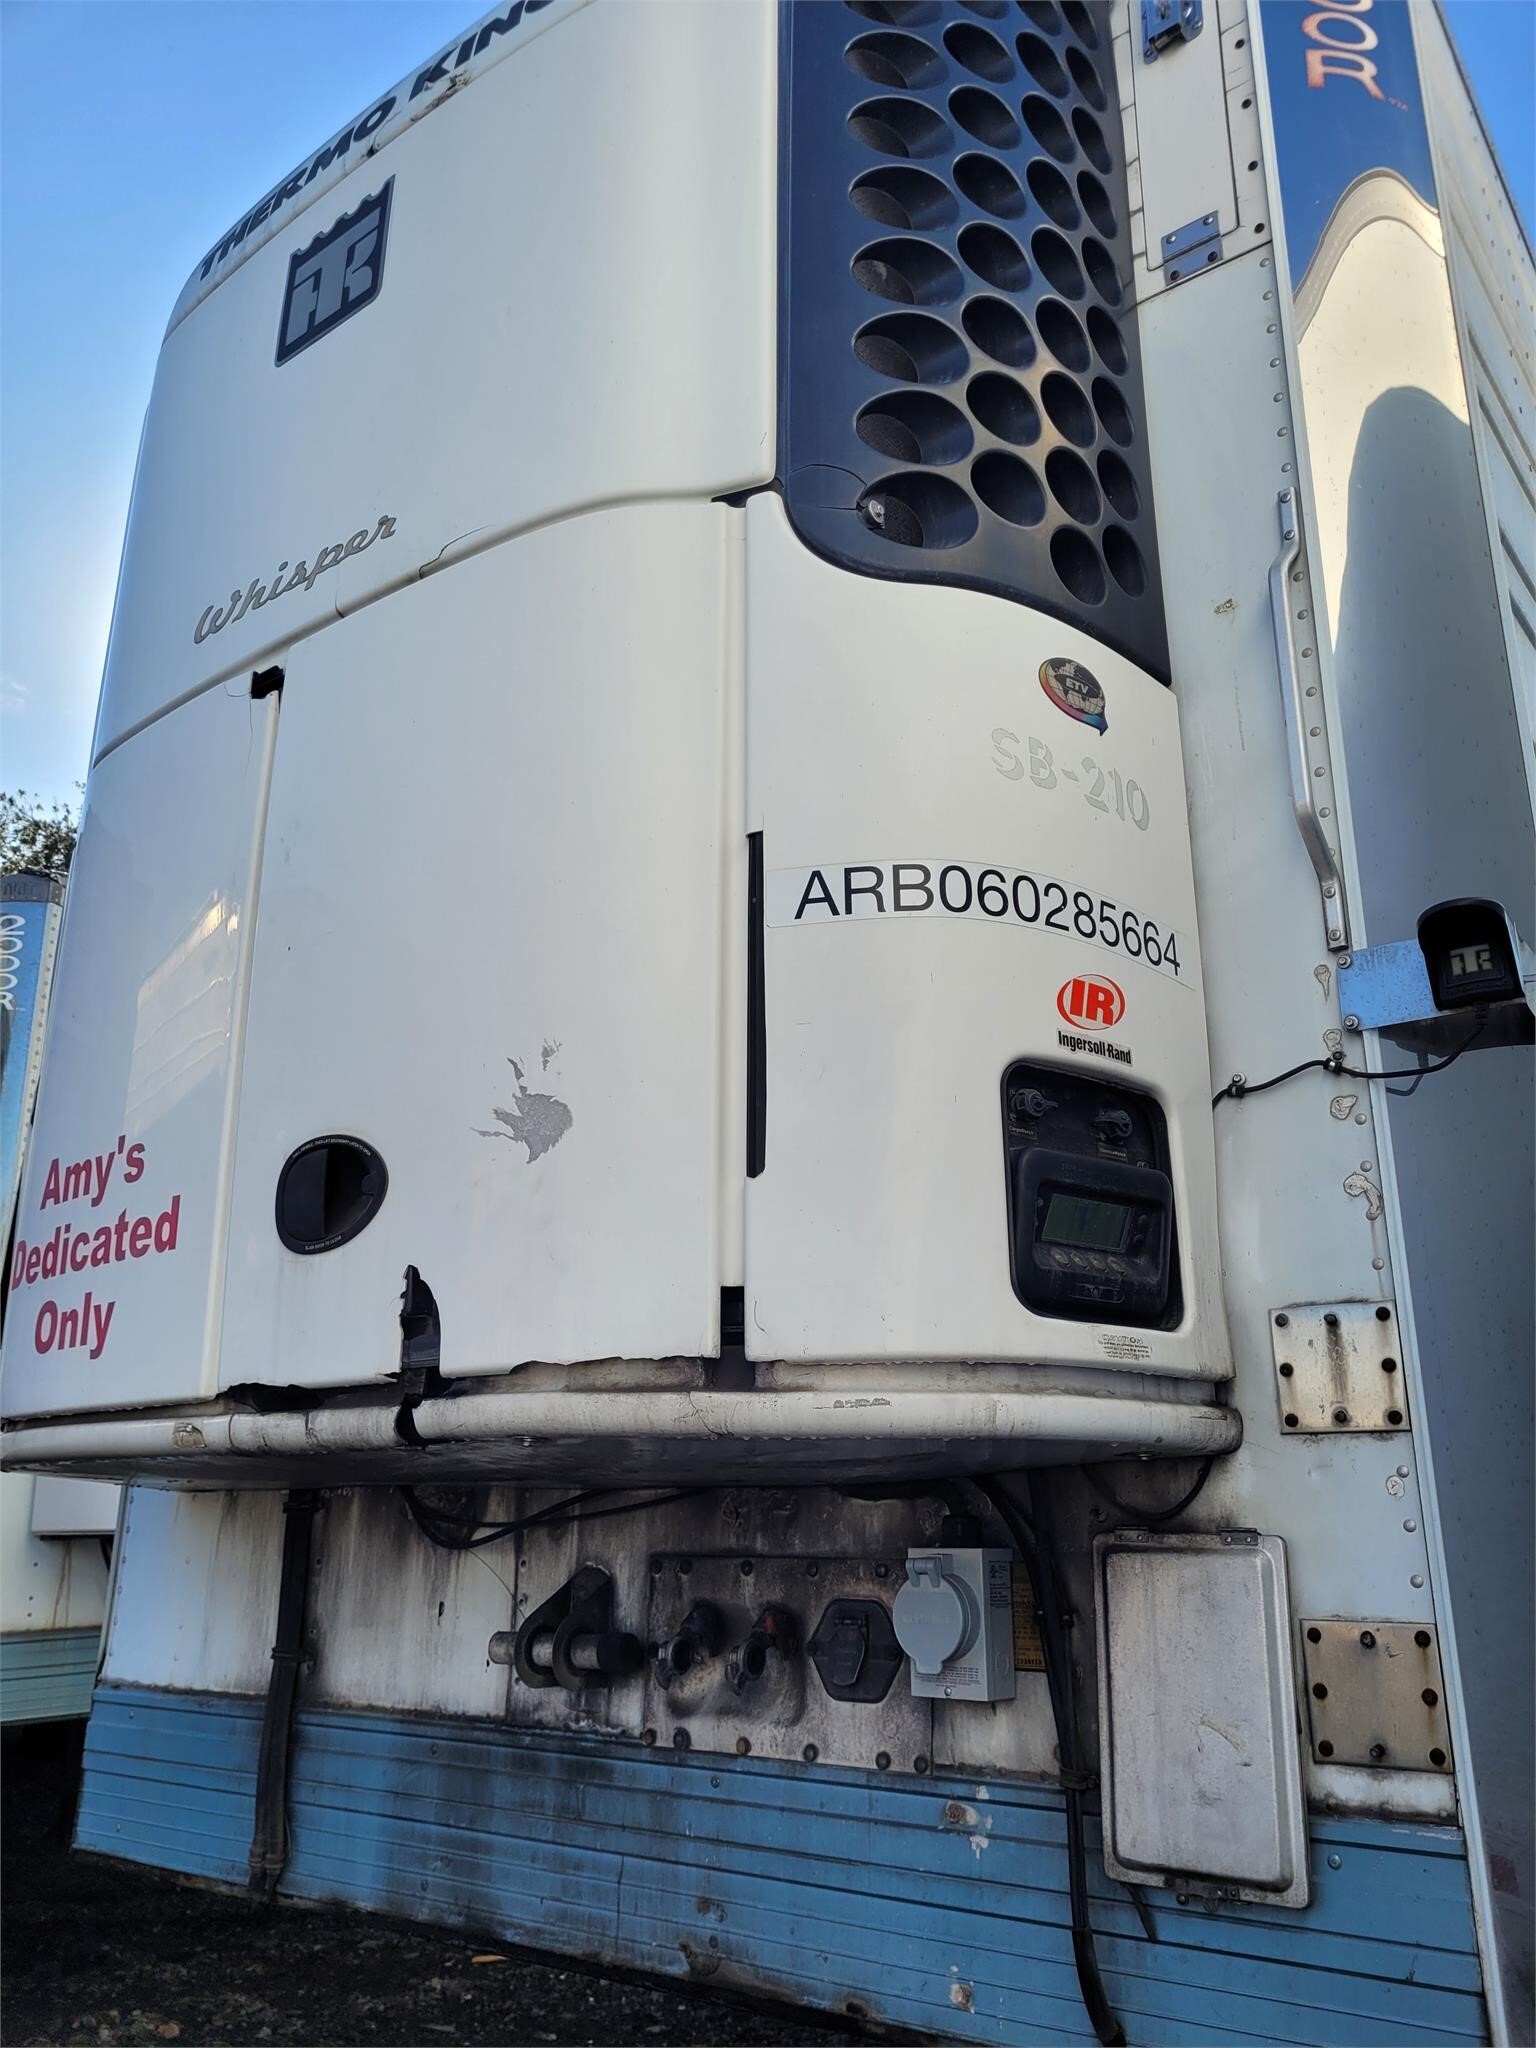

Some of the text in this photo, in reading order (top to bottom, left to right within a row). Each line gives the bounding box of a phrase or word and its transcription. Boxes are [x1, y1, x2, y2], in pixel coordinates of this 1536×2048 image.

[200, 96, 397, 281] THERMO
[194, 515, 397, 645] Whisper
[1065, 678, 1089, 694] ETV
[991, 727, 1150, 832] SB-210
[794, 863, 1182, 976] ARB060285664
[1069, 978, 1115, 1027] IR
[40, 1134, 146, 1211] Amy's
[11, 1194, 181, 1291] Dedicated
[35, 1291, 116, 1360] Only
